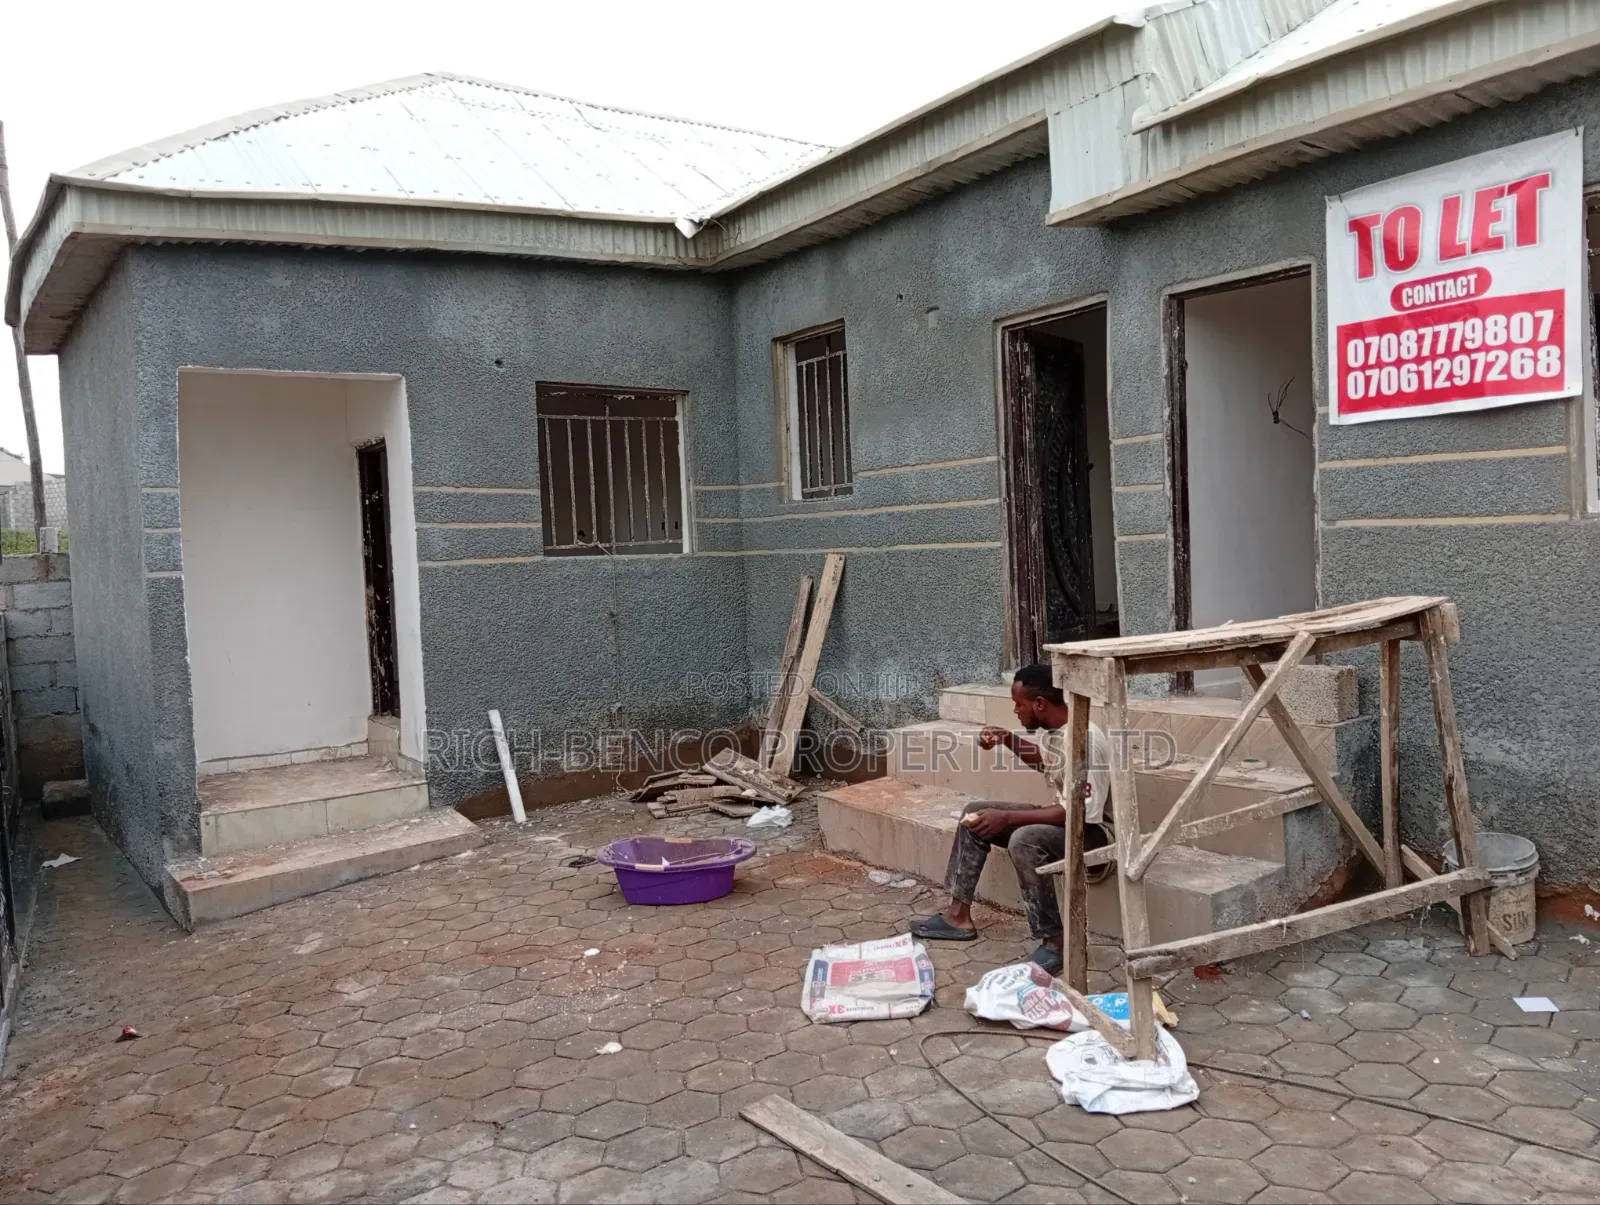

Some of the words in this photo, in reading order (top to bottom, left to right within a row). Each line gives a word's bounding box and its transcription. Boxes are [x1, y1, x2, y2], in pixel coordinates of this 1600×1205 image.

[1346, 205, 1422, 281] TO
[1438, 172, 1551, 263] LET
[1402, 274, 1478, 308] CONTACT
[1347, 309, 1554, 369] 07087779807
[1347, 345, 1561, 400] 07061297268
[828, 1004, 846, 1015] 3X
